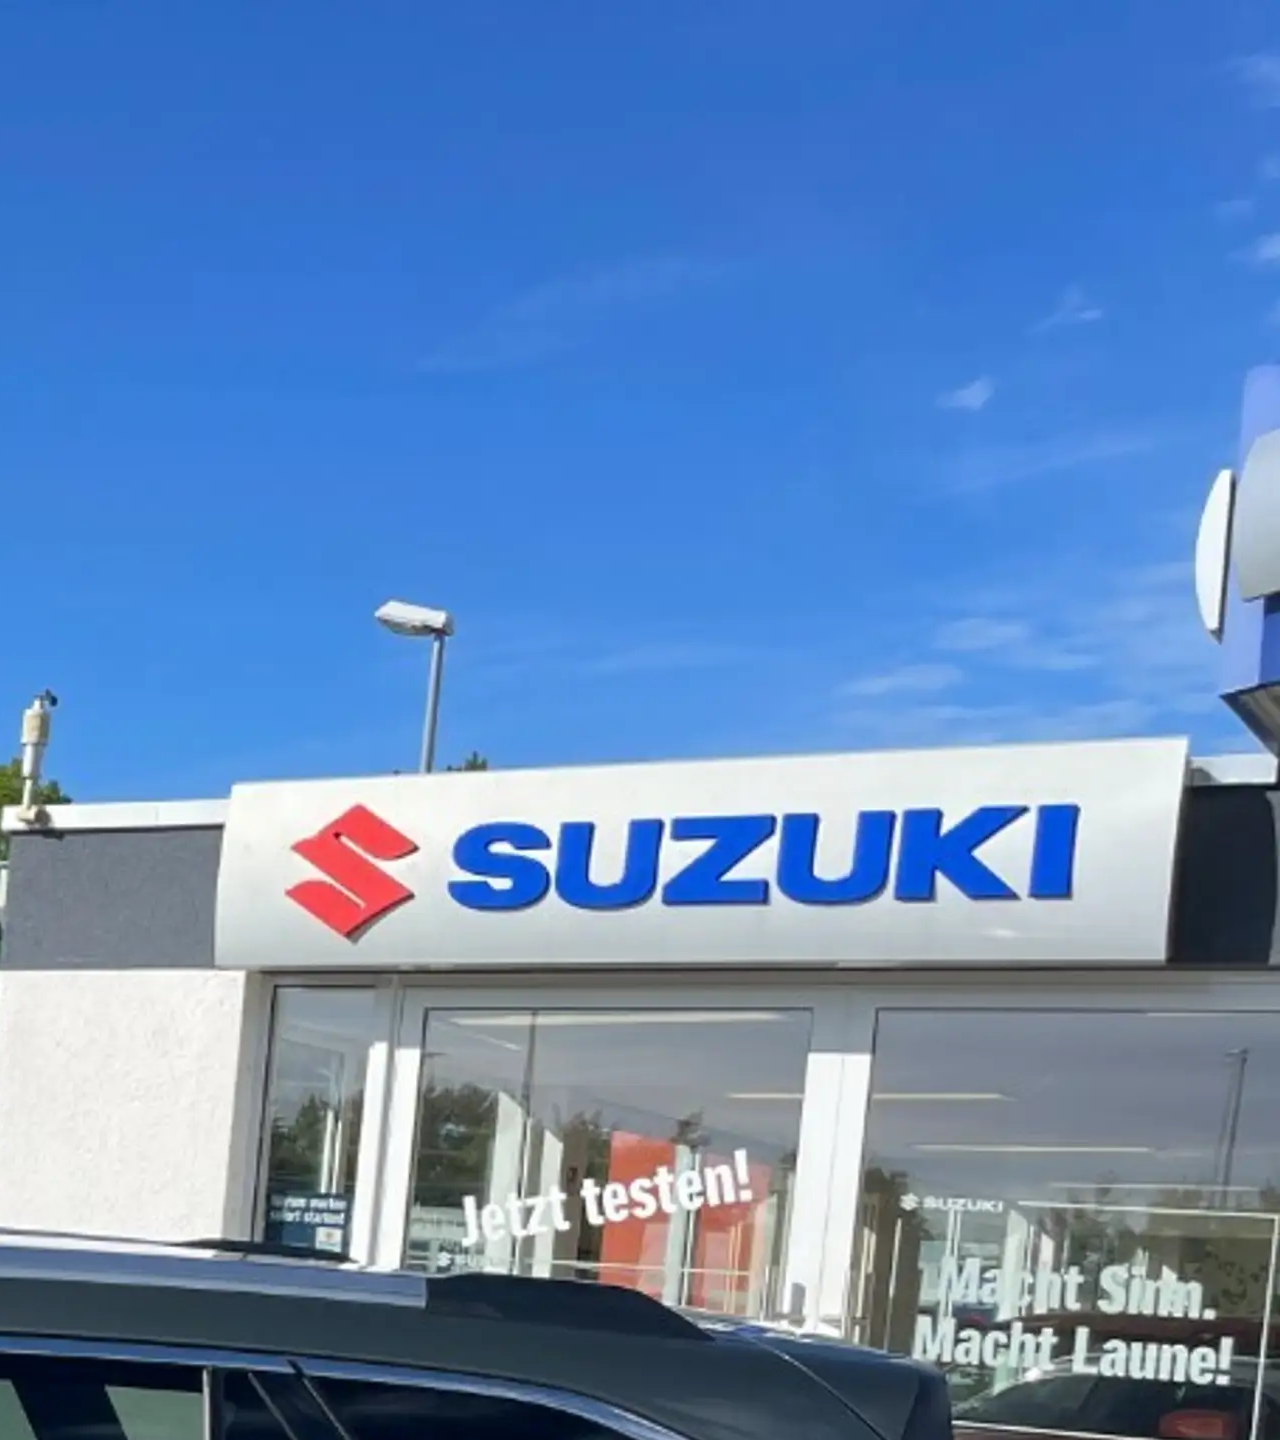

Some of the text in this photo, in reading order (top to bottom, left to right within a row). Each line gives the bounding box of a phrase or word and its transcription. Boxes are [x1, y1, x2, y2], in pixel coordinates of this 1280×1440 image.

[447, 803, 1080, 912] SUZUKI
[461, 1148, 754, 1248] Jetzt testen!
[937, 1255, 1218, 1320] Macht Sinn.
[913, 1314, 1235, 1386] Macht Laune!
